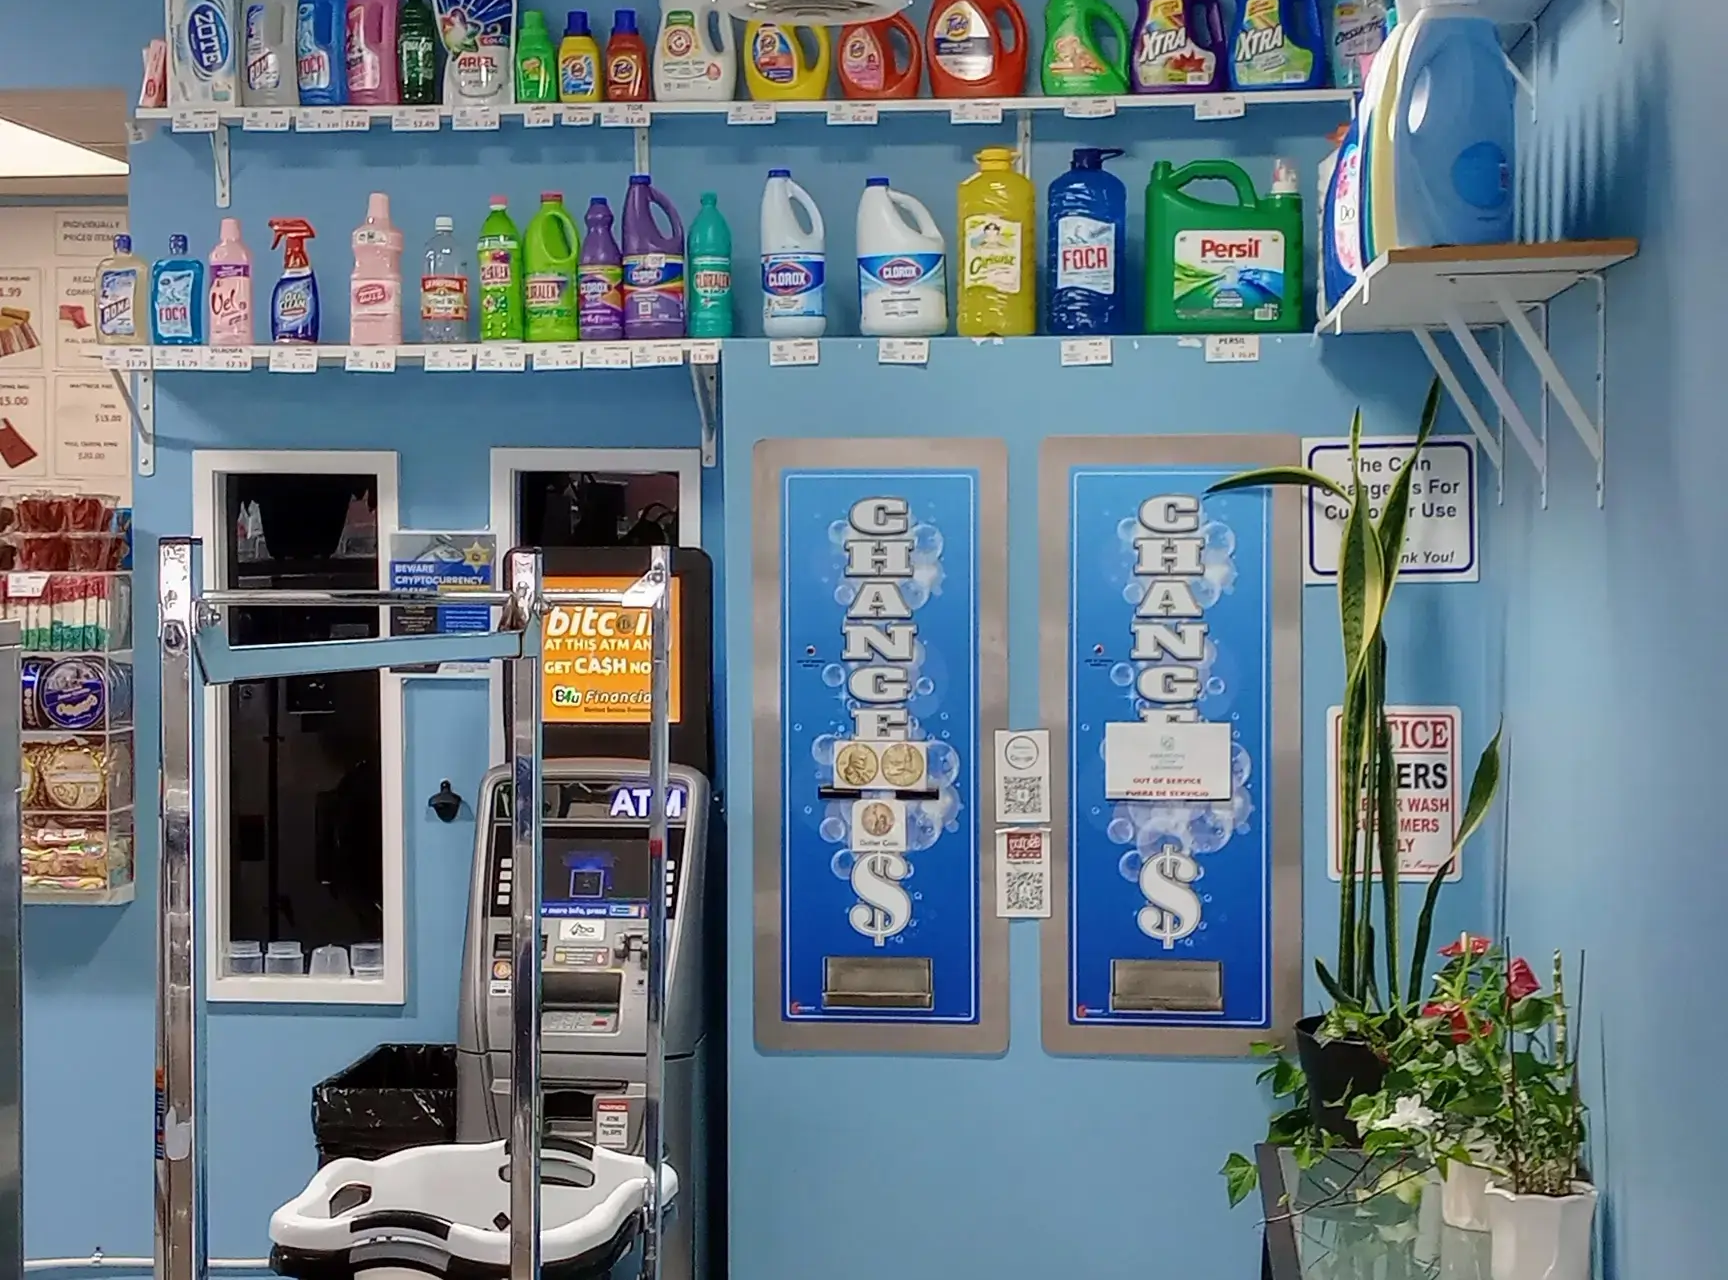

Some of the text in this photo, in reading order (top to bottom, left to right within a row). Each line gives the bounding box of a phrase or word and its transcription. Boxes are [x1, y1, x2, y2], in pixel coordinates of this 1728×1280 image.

[946, 16, 969, 33] Tide
[193, 10, 223, 67] ZOTE
[1138, 27, 1187, 65] XTRA
[1235, 25, 1283, 63] XTRA
[457, 57, 498, 69] ARIEL
[612, 62, 634, 77] Tide
[1200, 238, 1260, 258] Persil
[1062, 247, 1108, 271] FOCA
[768, 271, 807, 287] CLOROX
[882, 265, 917, 279] CLOROX
[211, 289, 235, 315] Vel
[280, 299, 306, 310] CLEAN
[104, 297, 131, 323] ROMA
[159, 306, 188, 321] FOCA
[1218, 337, 1245, 345] PERSIL
[1388, 456, 1431, 472] Cin
[1428, 478, 1460, 495] For
[1421, 503, 1457, 518] Use
[1423, 550, 1455, 564] You!
[394, 563, 434, 574] BEWARE
[394, 576, 484, 586] CRYPTOCURRENCY
[842, 496, 918, 741] CHANGE
[544, 639, 652, 651] AT THIS ATM AN
[544, 656, 652, 676] GET CA$H NO
[585, 690, 652, 704] Financia
[1407, 798, 1449, 813] WASH
[568, 906, 586, 916] info,
[586, 908, 607, 916] press
